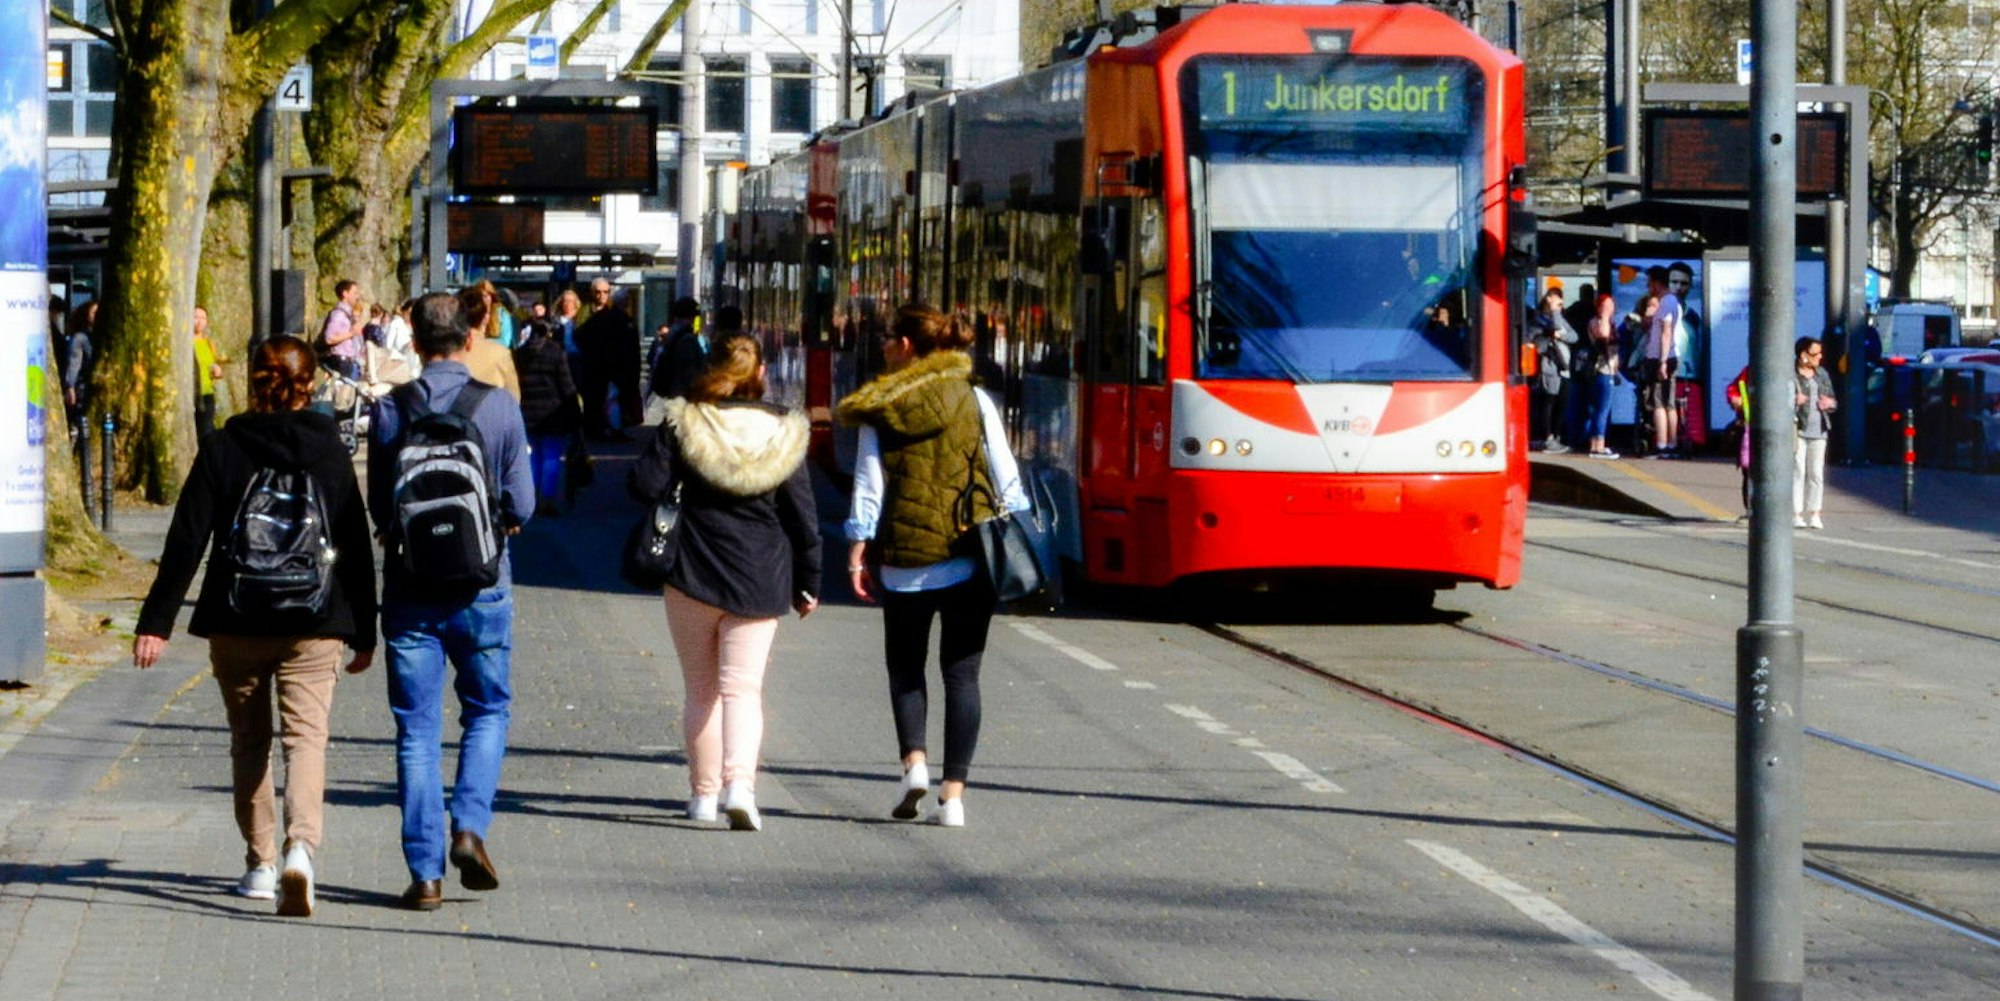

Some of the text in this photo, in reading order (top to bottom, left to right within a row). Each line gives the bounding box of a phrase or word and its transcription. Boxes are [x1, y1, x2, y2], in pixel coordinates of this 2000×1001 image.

[283, 79, 305, 104] 4
[1222, 72, 1450, 115] 1 Junkersdorf
[1324, 420, 1351, 431] KVB
